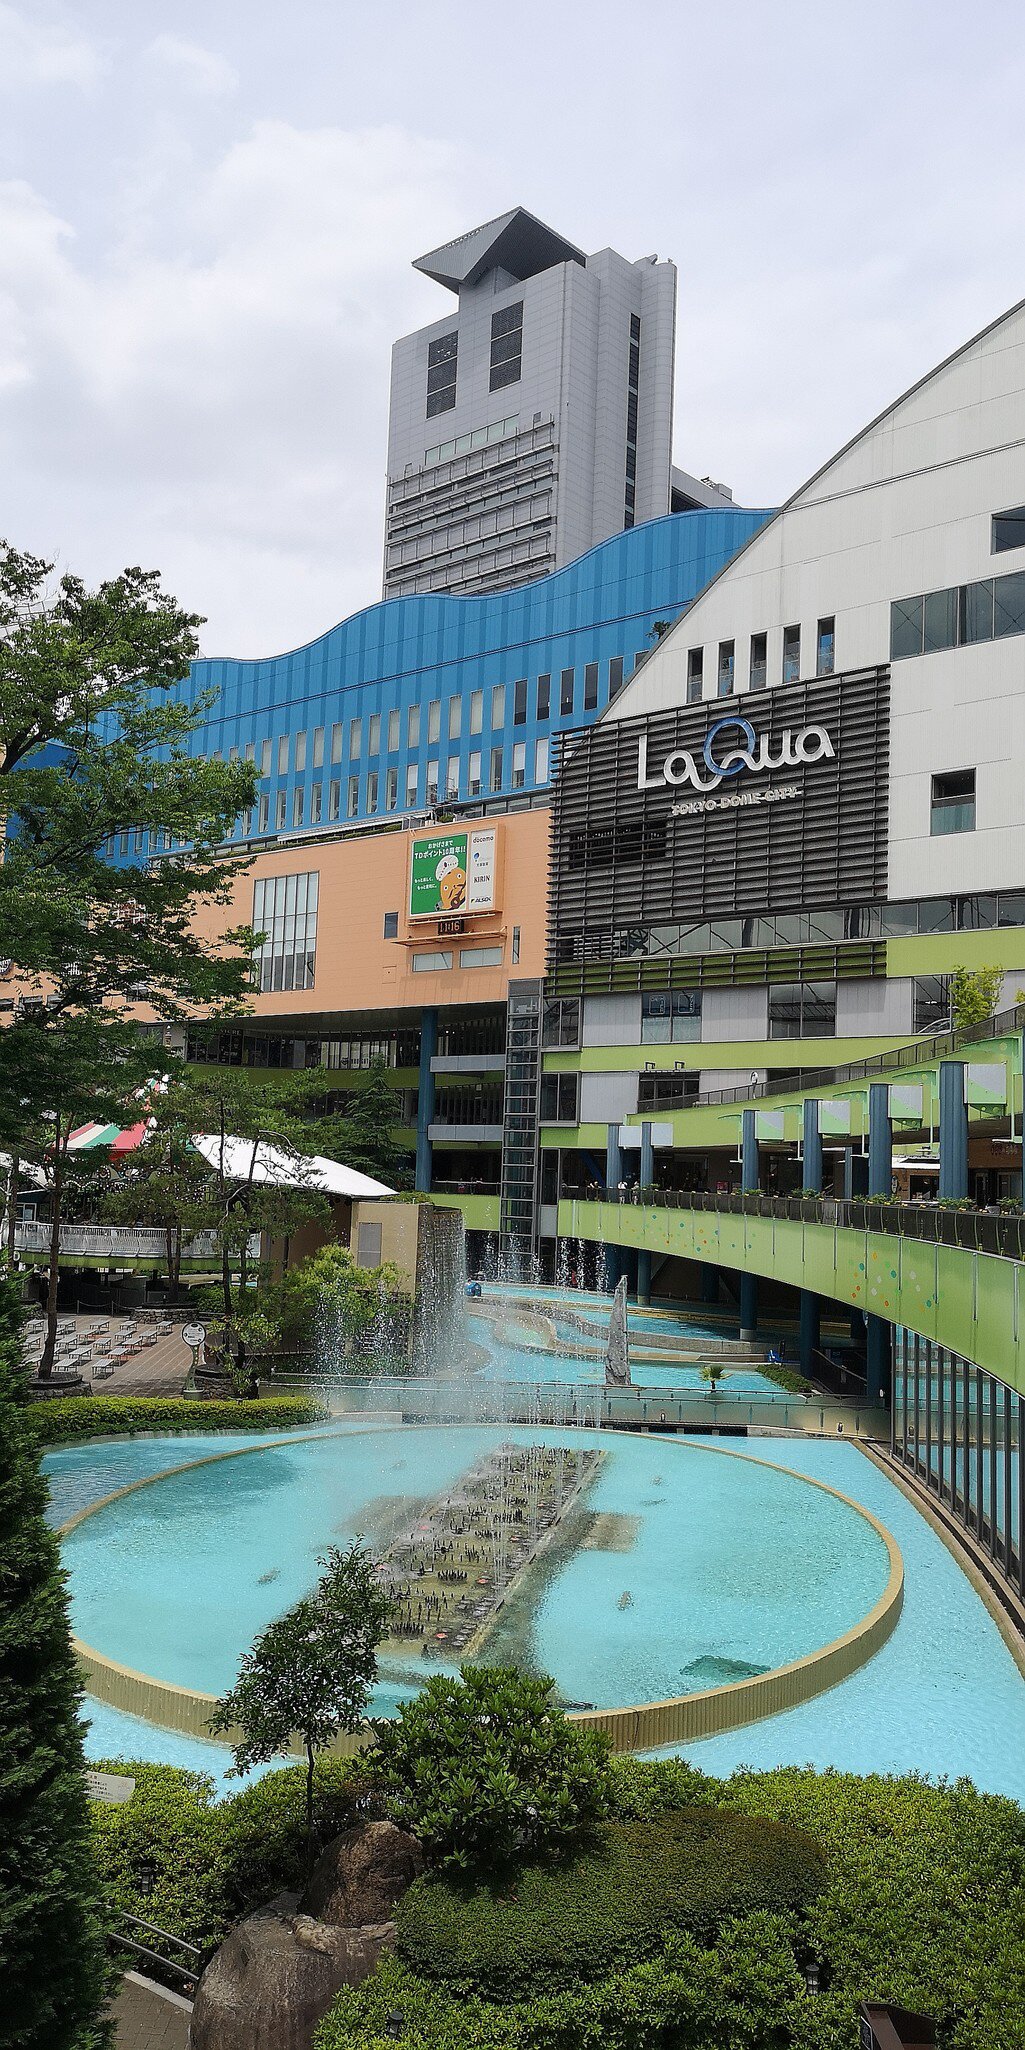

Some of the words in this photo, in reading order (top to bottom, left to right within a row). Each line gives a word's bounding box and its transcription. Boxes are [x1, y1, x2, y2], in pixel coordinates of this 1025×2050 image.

[637, 716, 835, 792] LaQua
[671, 799, 718, 816] TOKYO
[720, 792, 762, 809] DOME
[764, 786, 799, 802] CITY
[427, 840, 454, 849] おかげさまで
[473, 875, 491, 883] KIRIN
[440, 921, 460, 932] 11:16
